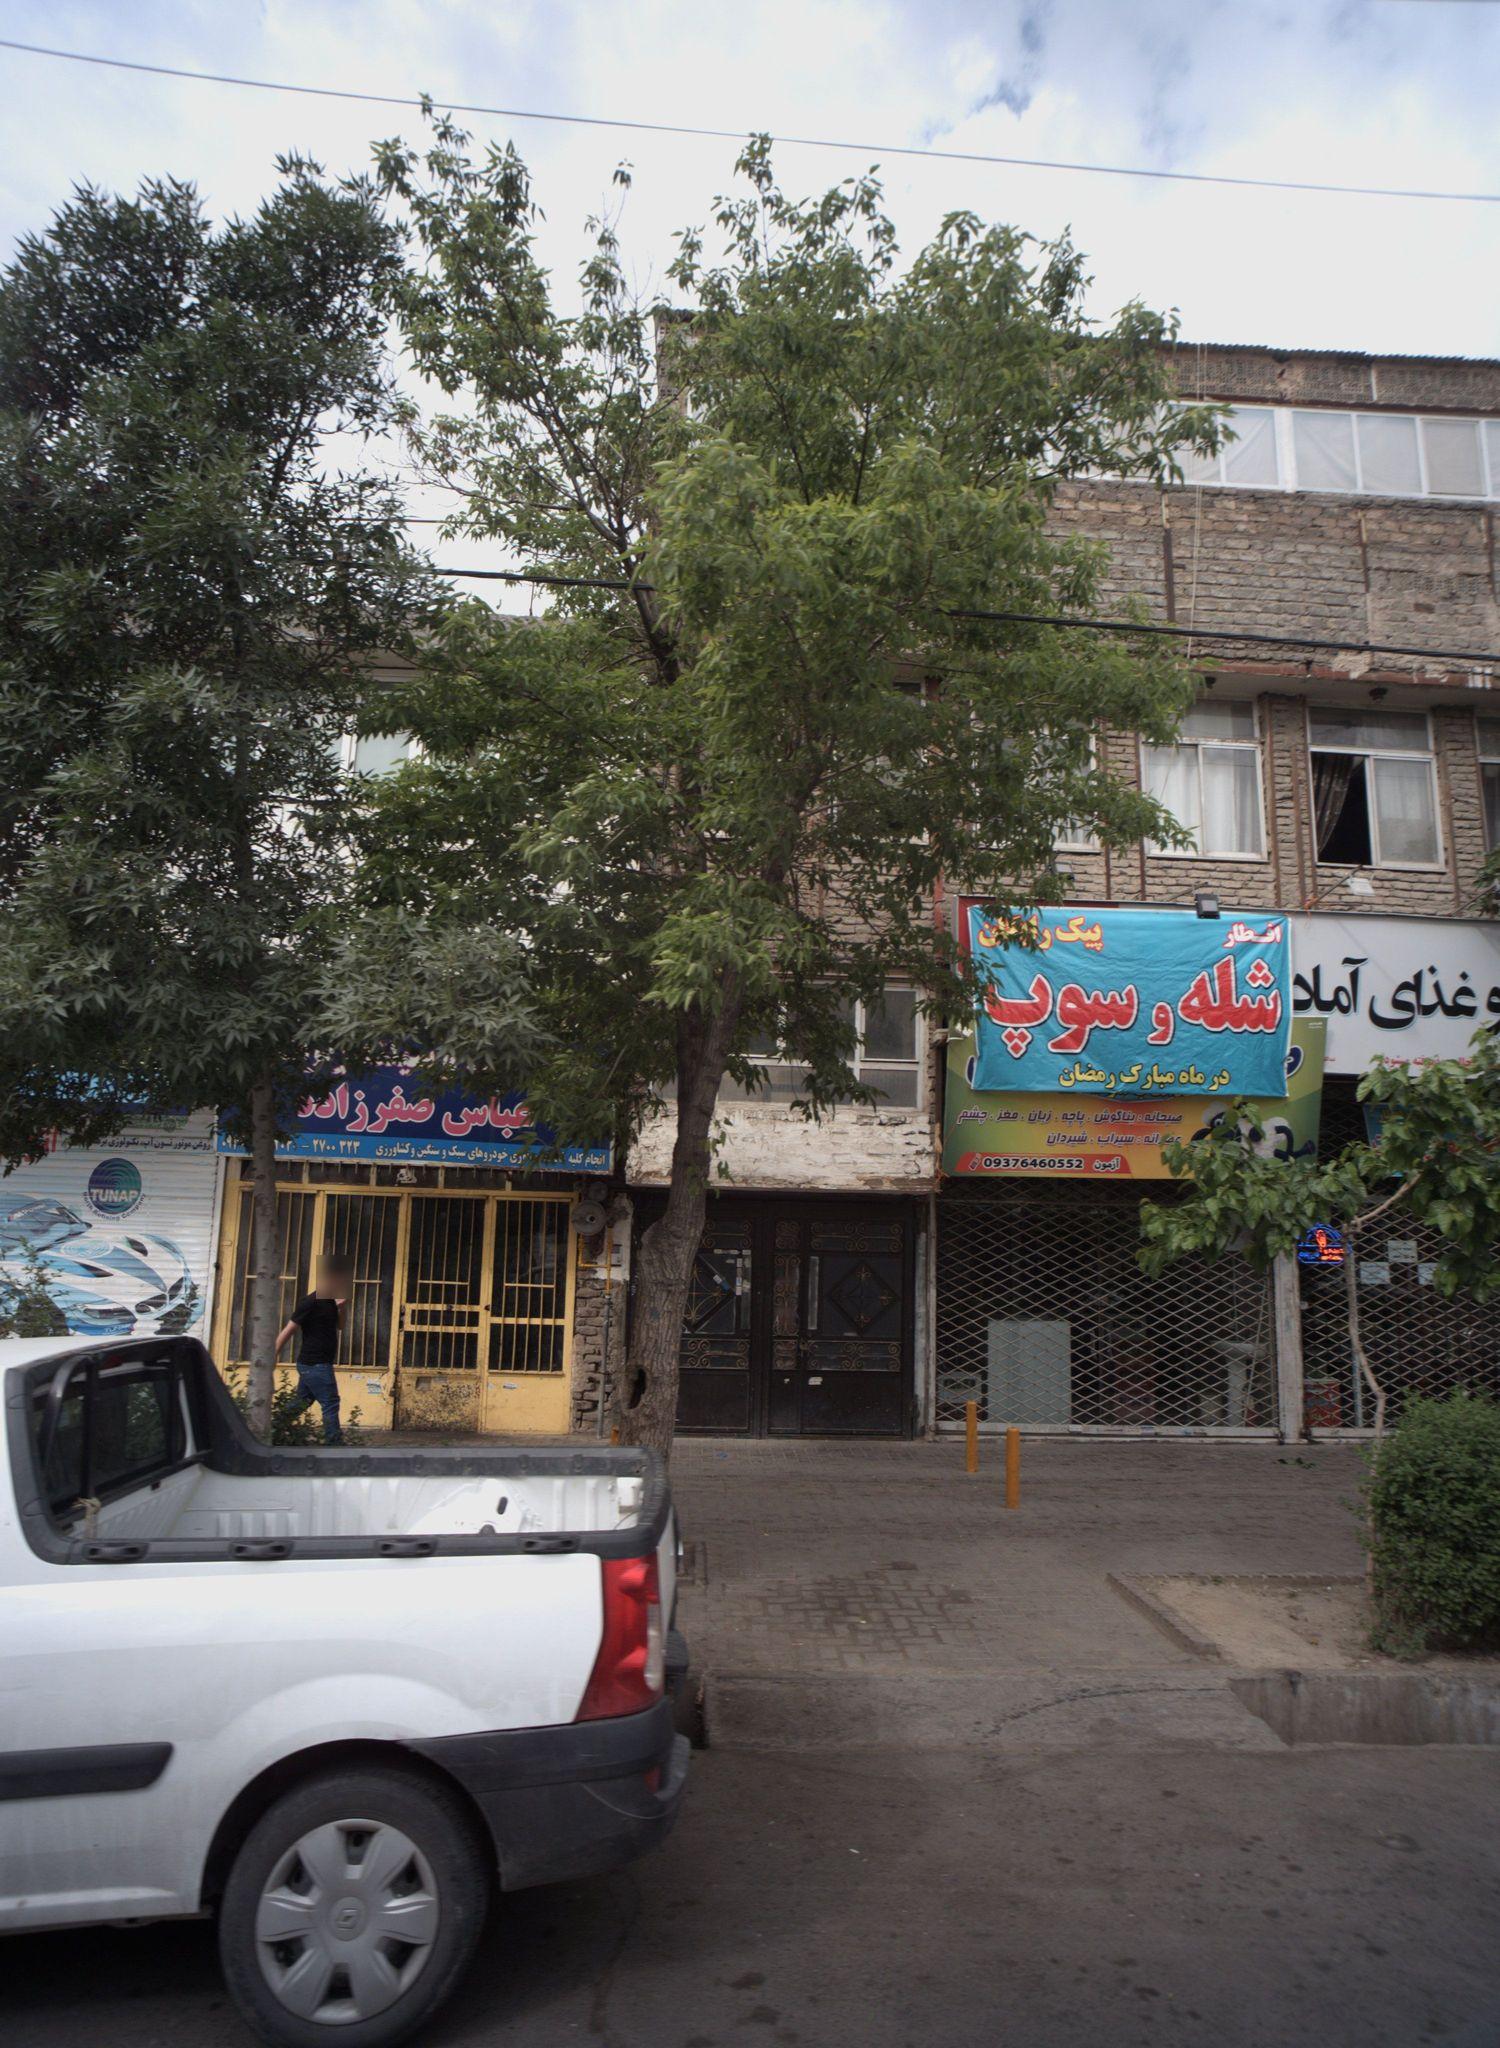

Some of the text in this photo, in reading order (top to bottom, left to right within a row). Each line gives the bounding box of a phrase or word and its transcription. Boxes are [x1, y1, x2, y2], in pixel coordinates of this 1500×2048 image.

[1055, 916, 1104, 952] پیک
[1222, 922, 1283, 948] افطار
[1369, 965, 1477, 1030] غذای
[984, 954, 1283, 1059] شله و سوپ
[1058, 1061, 1231, 1090] در ماه مبارک رمضان
[957, 1106, 988, 1126] چشم
[996, 1107, 1018, 1122] مغز
[1027, 1108, 1052, 1122] زبان
[1061, 1109, 1085, 1126] پاچه
[1143, 1109, 1183, 1126] صبحانه
[1046, 1131, 1088, 1146] شیردان
[1097, 1131, 1134, 1147] سیراب
[375, 1141, 411, 1157] کشاورزی
[416, 1143, 440, 1157] سنگین
[448, 1145, 466, 1159] سبک
[467, 1147, 508, 1163] خودروهای
[568, 1151, 584, 1166] کلیه
[585, 1152, 606, 1167] انجام
[983, 1157, 1085, 1169] 09376460552
[1093, 1155, 1121, 1172] آزمون
[89, 1188, 139, 1203] TUNAP
